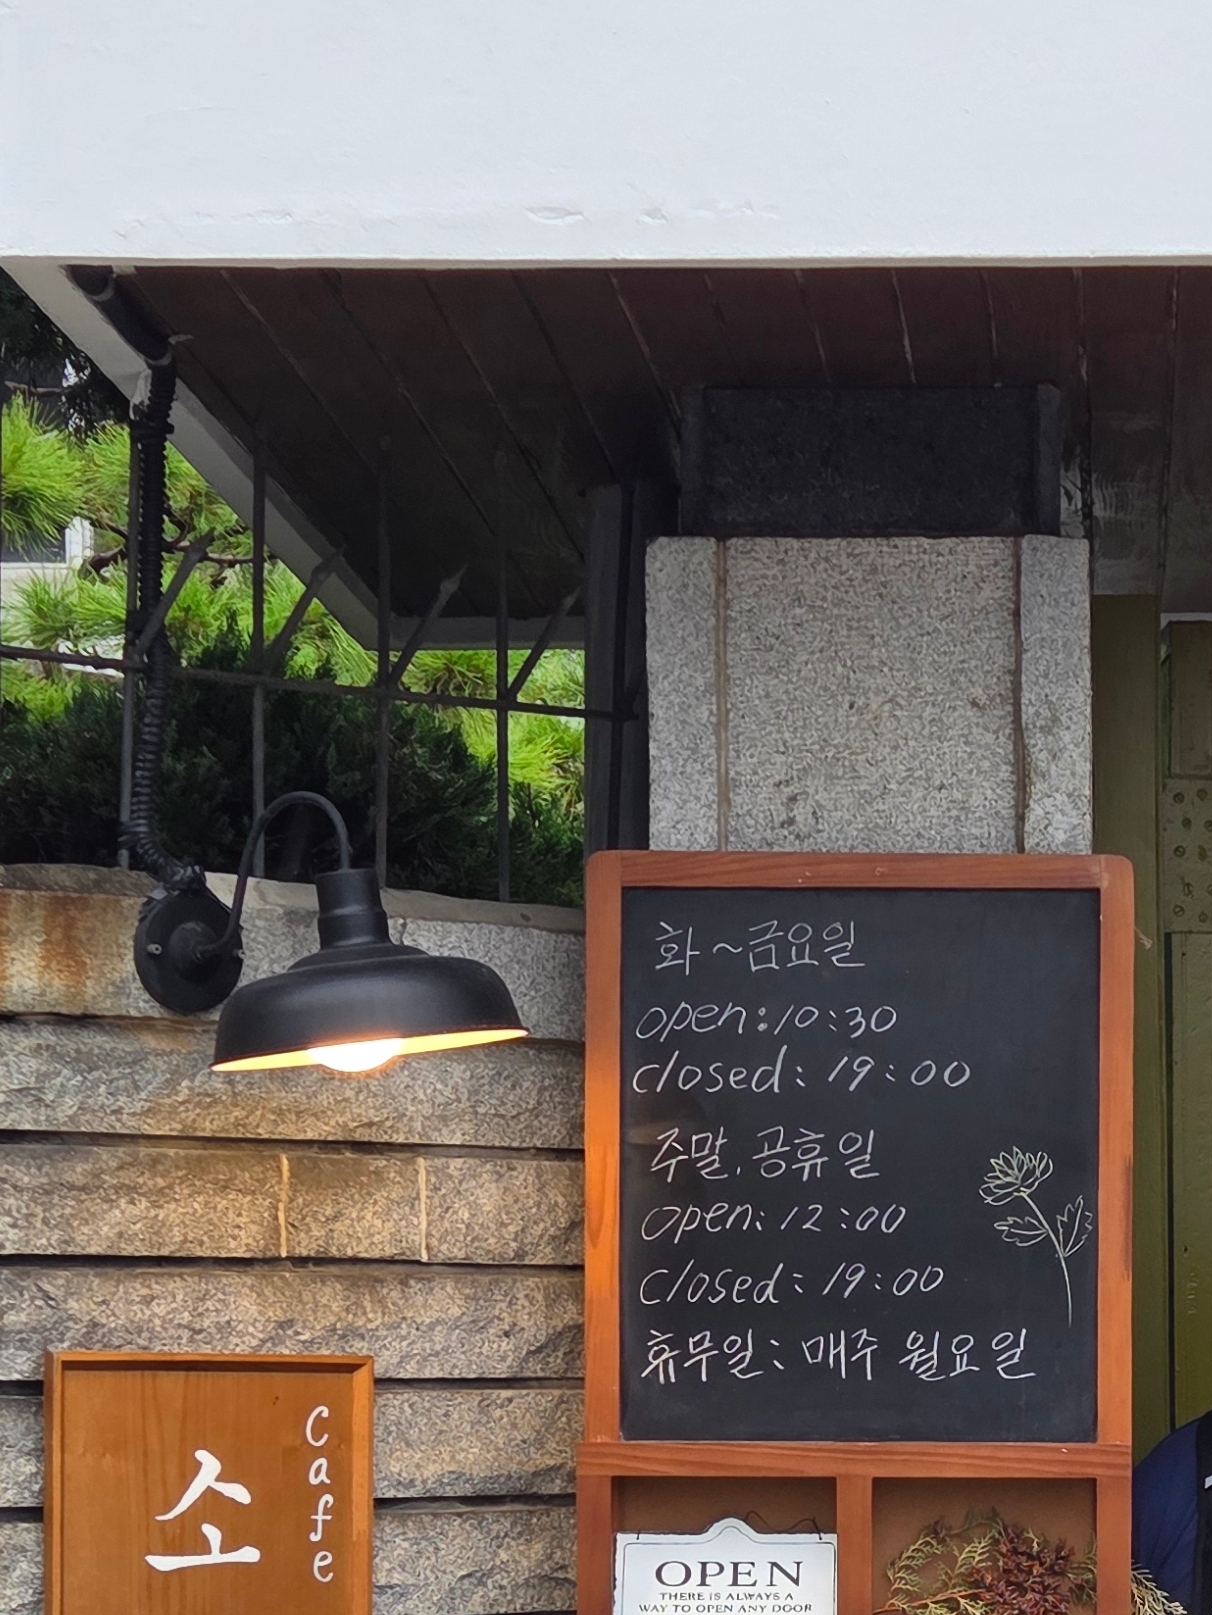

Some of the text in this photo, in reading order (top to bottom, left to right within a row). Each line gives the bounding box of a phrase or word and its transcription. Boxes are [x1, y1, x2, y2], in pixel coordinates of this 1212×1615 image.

[801, 1328, 879, 1381] 매주
[655, 1560, 803, 1587] OPEN
[659, 1592, 794, 1601] THERE IS ALWAYS A
[638, 1604, 812, 1613] WAY TO OPEN ANY DOOR
